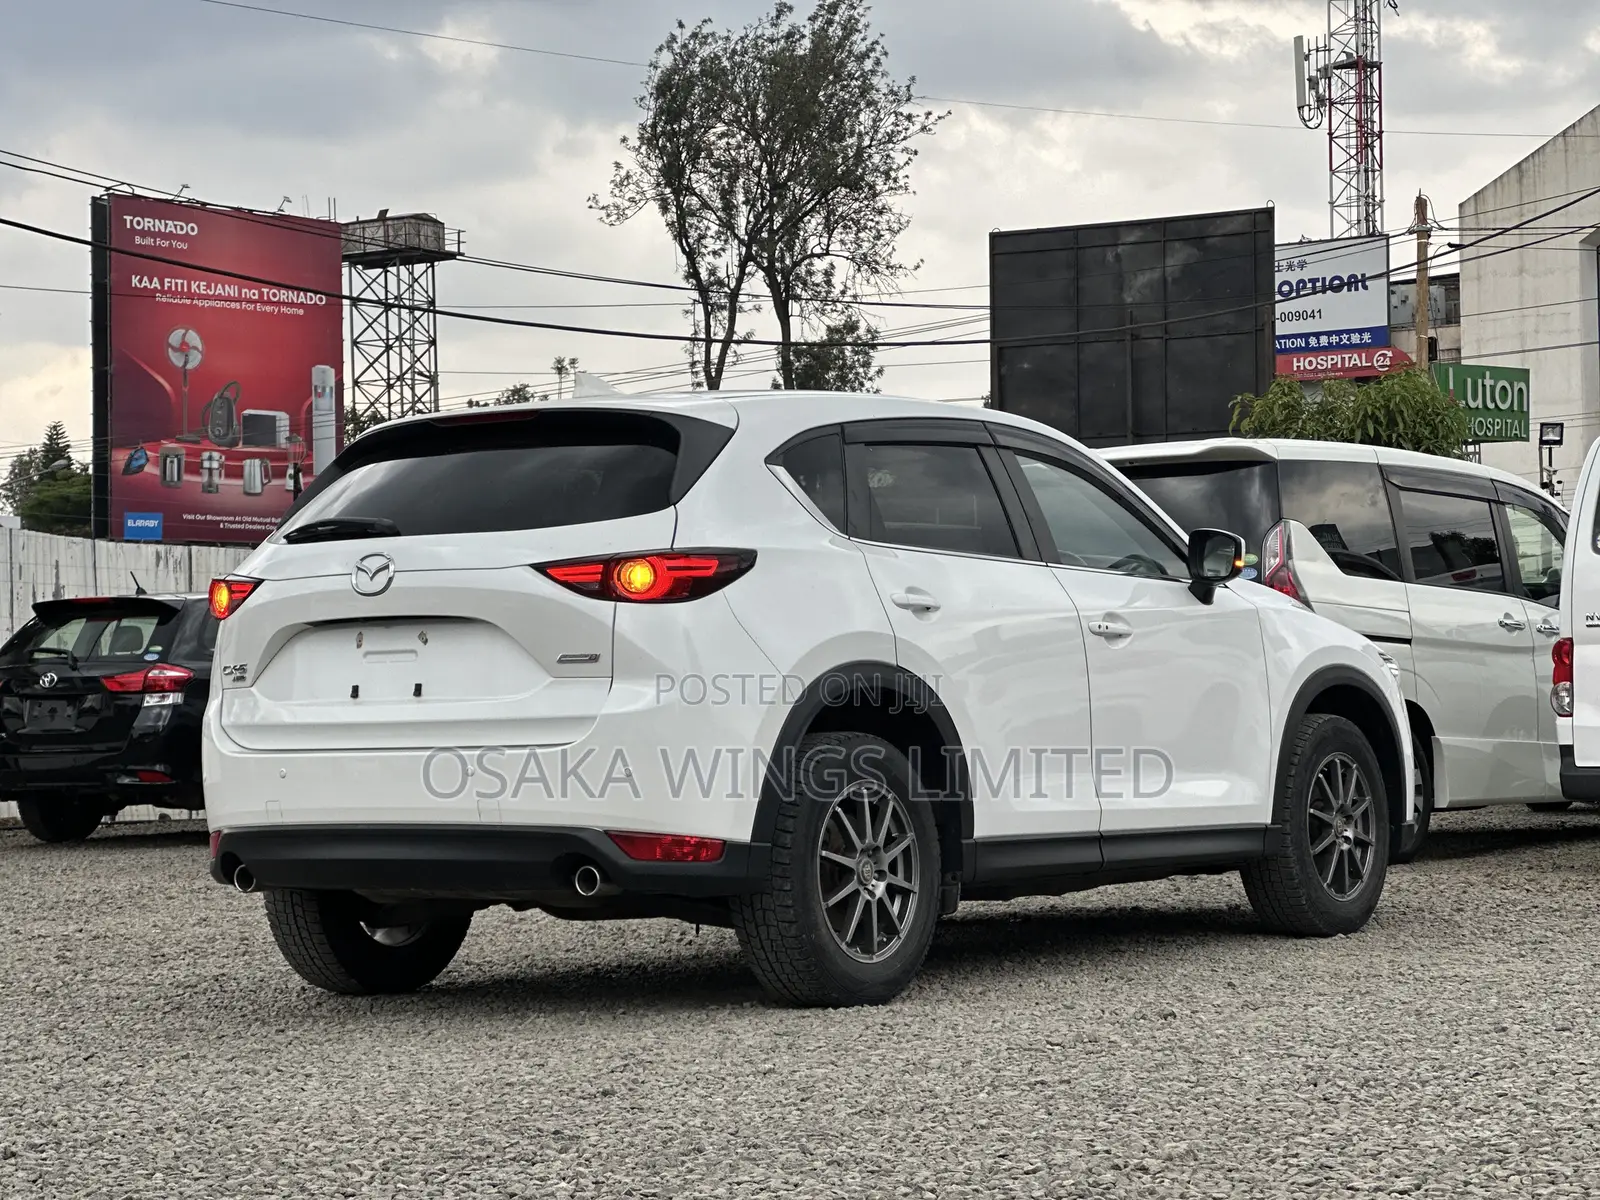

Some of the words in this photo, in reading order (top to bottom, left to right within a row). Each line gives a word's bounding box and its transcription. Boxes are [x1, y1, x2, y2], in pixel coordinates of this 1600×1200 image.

[123, 215, 198, 236] TORNADO
[135, 235, 154, 246] Built
[156, 238, 170, 248] For
[171, 239, 188, 250] You
[131, 274, 161, 290] KAA
[164, 277, 187, 292] FITI
[191, 281, 239, 298] KEJANI
[241, 287, 259, 299] na
[261, 287, 326, 306] TORNADO
[192, 296, 241, 310] Appliances
[241, 301, 255, 311] For
[256, 303, 279, 315] Every
[280, 305, 304, 316] Home
[1293, 353, 1372, 371] HOSPITAL
[1376, 356, 1391, 366] 24
